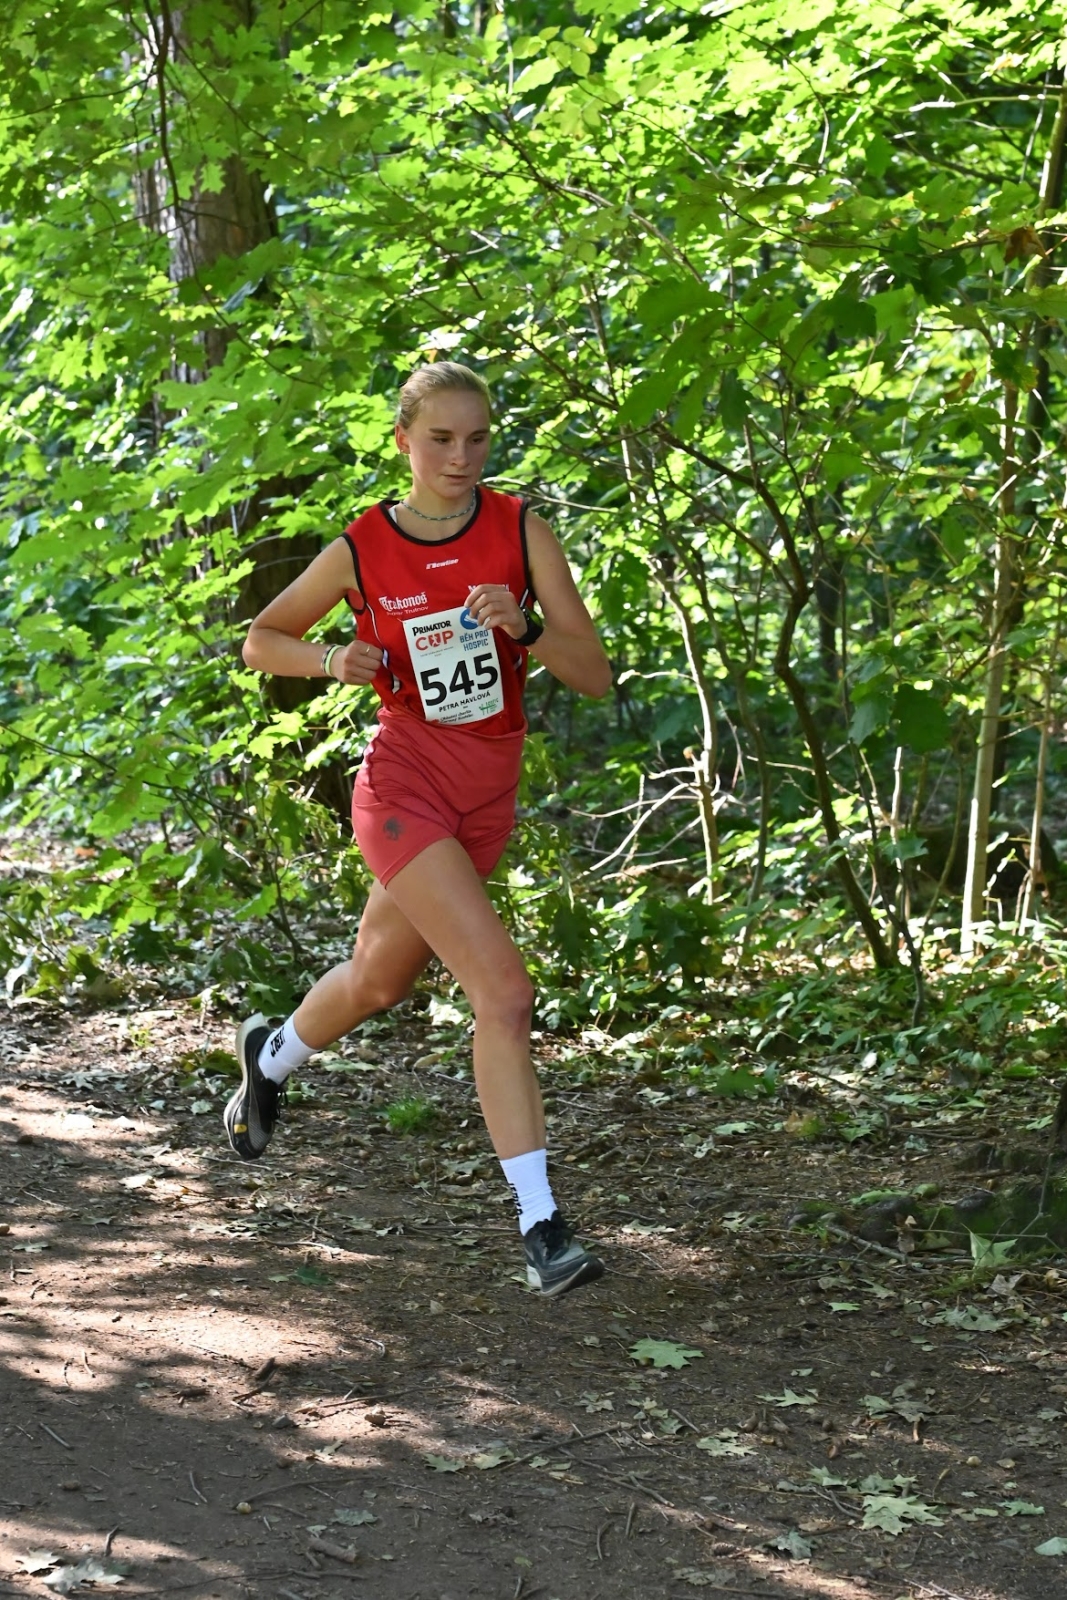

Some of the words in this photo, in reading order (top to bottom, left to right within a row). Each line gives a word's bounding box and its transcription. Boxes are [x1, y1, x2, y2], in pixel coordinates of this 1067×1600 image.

[415, 630, 454, 651] CUP
[459, 632, 474, 643] BĚH
[475, 629, 489, 639] PRO
[463, 639, 489, 651] HOSPIC
[420, 652, 498, 707] 545
[438, 701, 460, 713] PETRA
[460, 691, 491, 706] HAVLOVÁ
